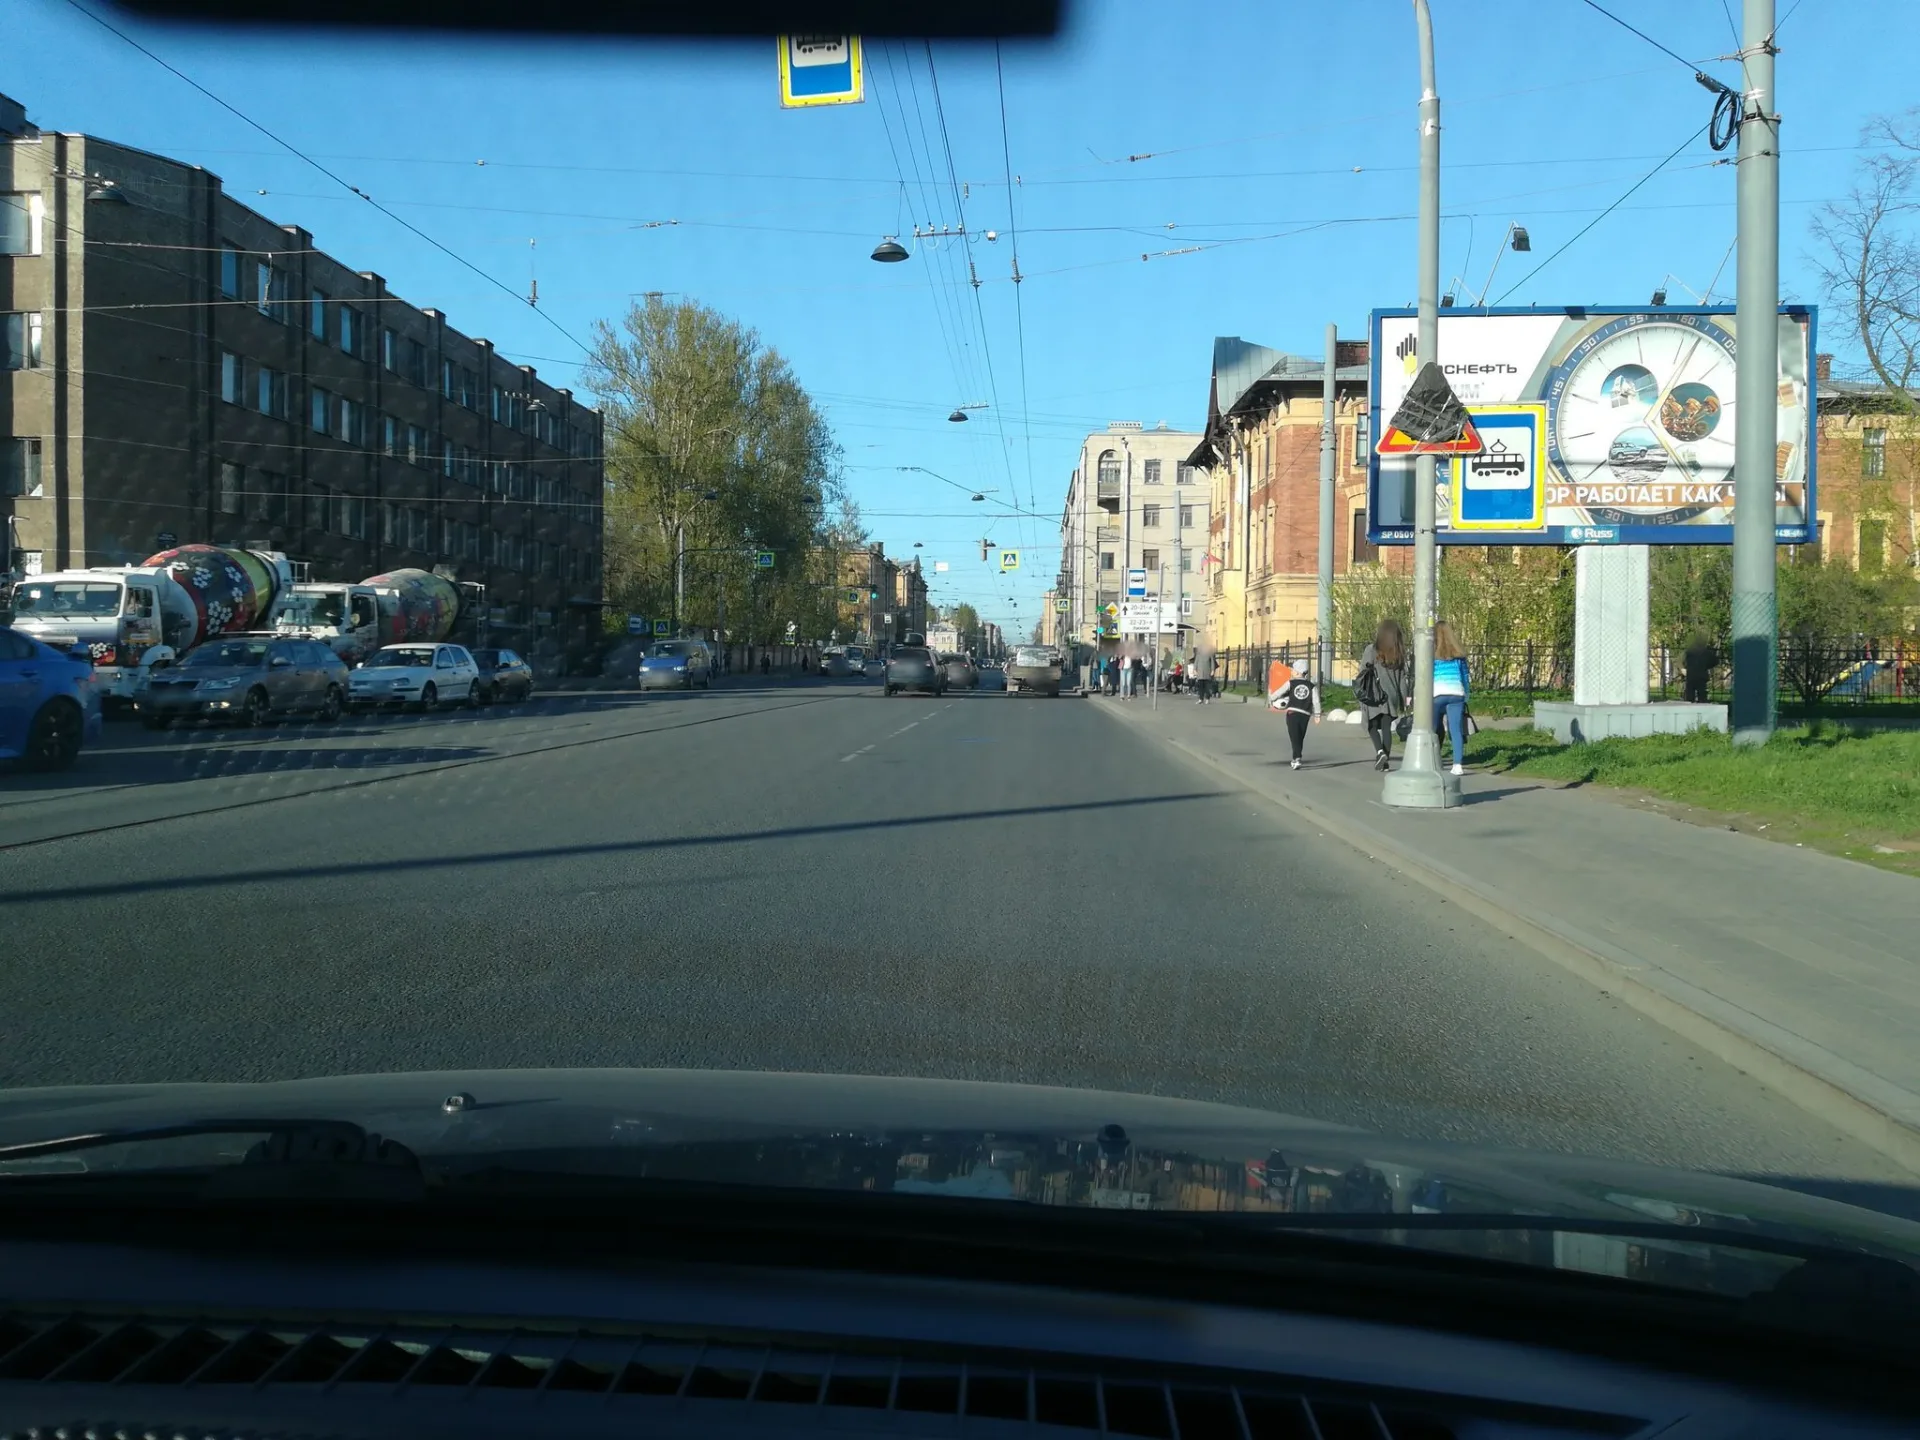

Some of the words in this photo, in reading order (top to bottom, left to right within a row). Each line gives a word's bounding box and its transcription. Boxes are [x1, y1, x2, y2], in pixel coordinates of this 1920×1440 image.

[1582, 338, 1597, 352] 50
[1576, 484, 1676, 504] РАБОТАЕТ
[1681, 484, 1723, 503] КАК
[1584, 527, 1614, 539] Russ
